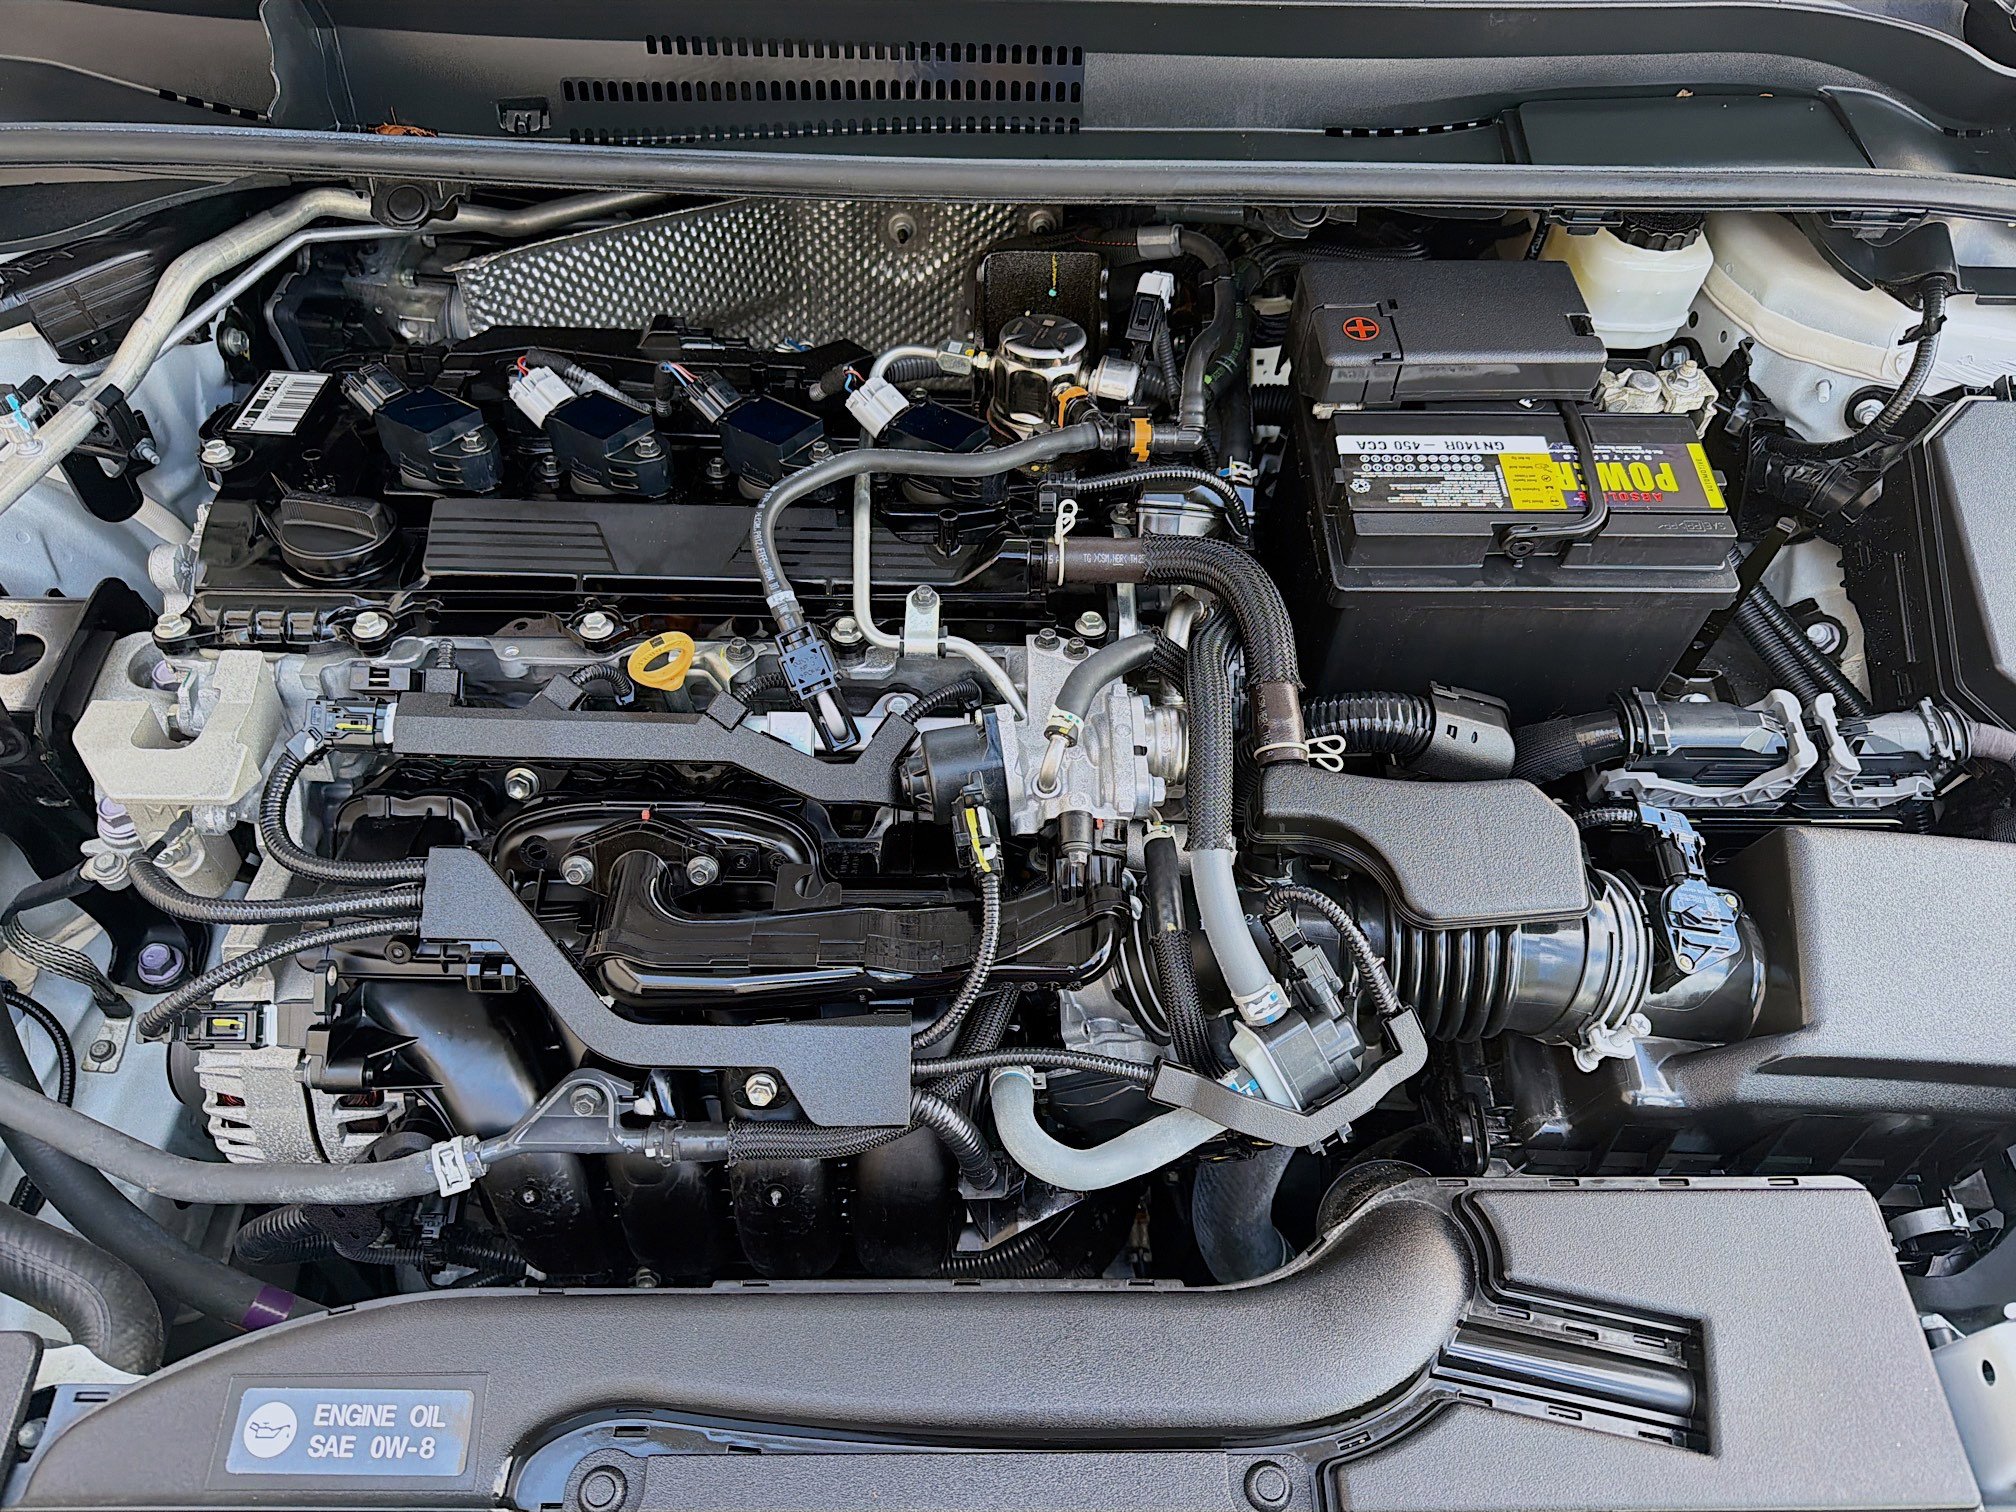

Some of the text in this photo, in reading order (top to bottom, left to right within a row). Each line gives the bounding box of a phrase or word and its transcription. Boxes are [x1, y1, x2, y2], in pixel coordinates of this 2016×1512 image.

[1356, 440, 1387, 450] CCA
[1446, 440, 1504, 451] GN140R
[1578, 492, 1664, 502] ABSOLE
[313, 1403, 446, 1428] ENGINE OIL
[307, 1435, 436, 1460] SAE 0W-8
